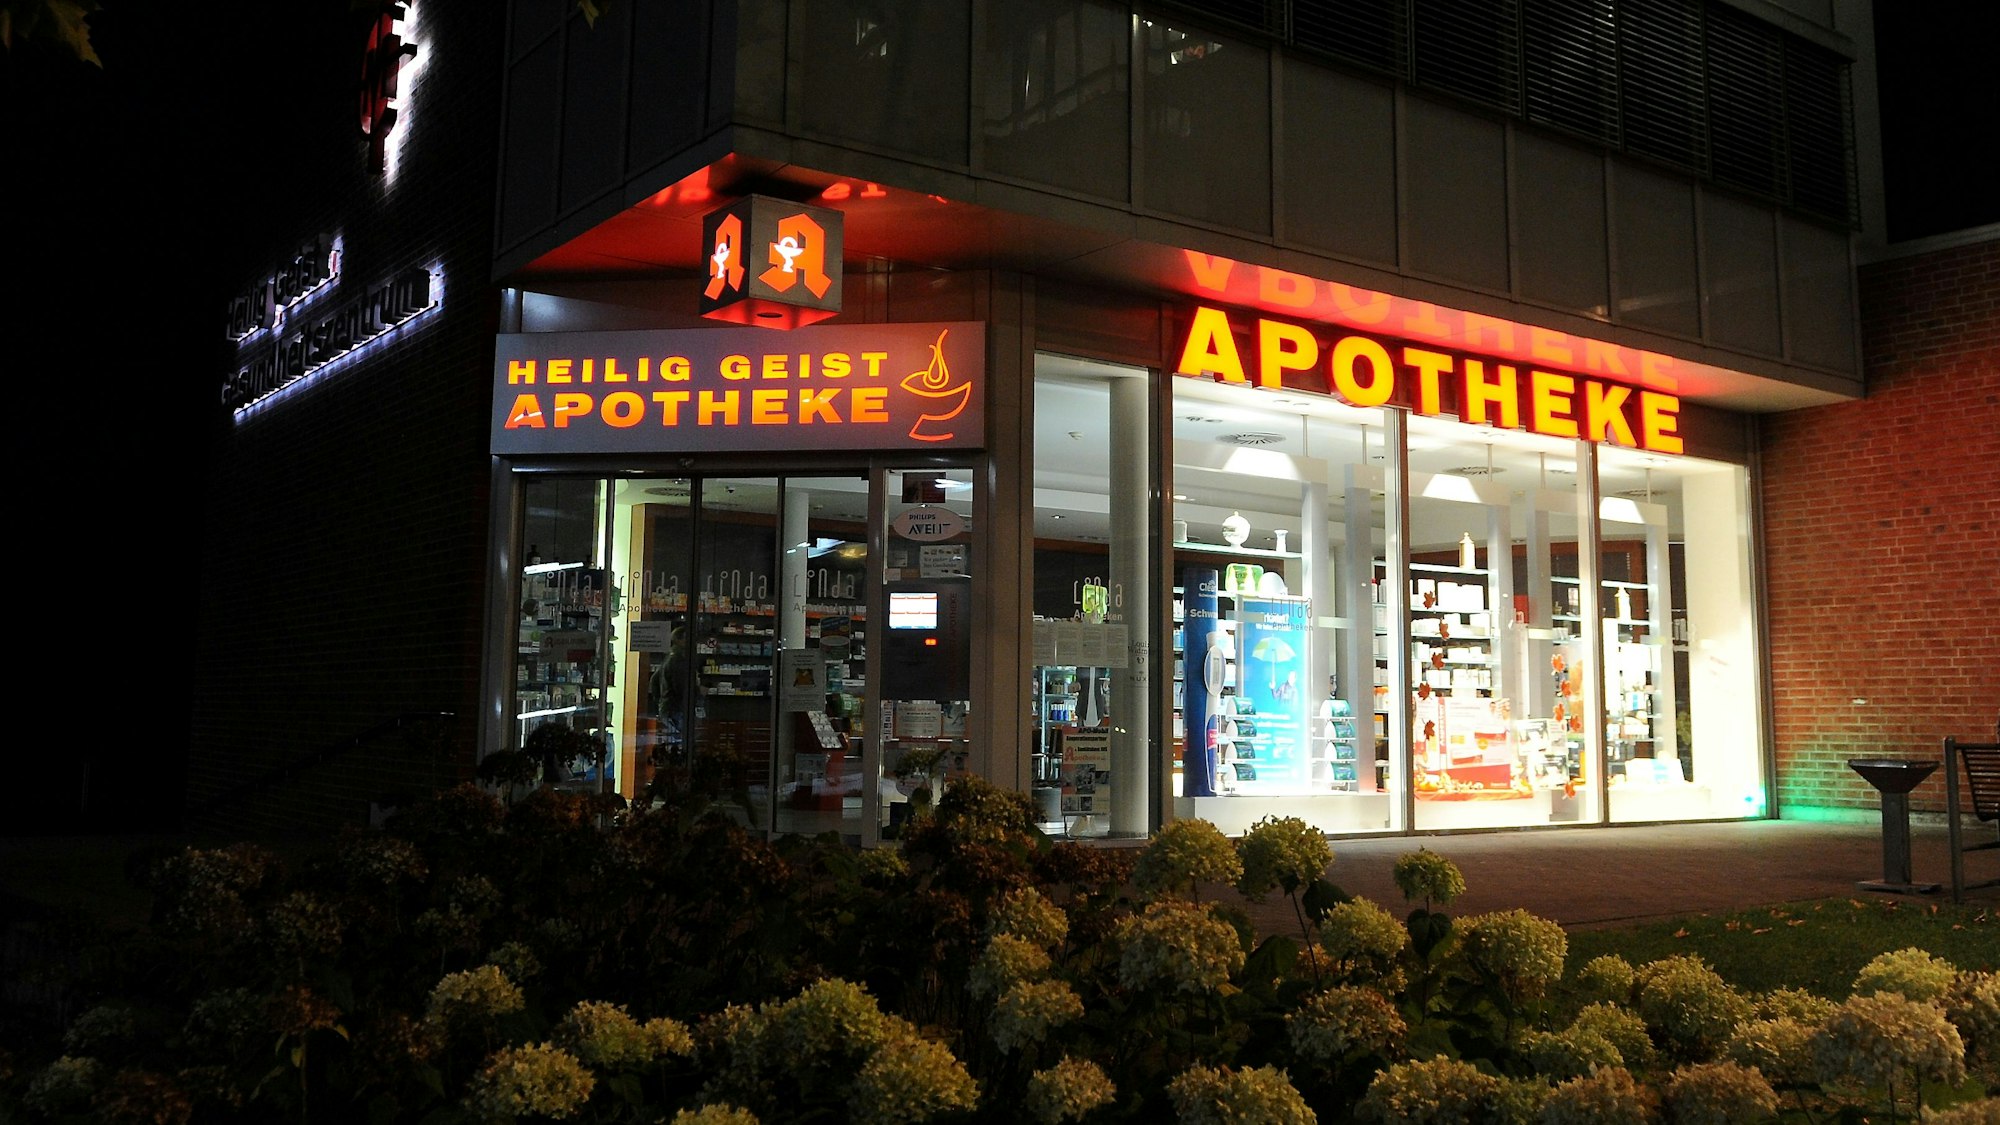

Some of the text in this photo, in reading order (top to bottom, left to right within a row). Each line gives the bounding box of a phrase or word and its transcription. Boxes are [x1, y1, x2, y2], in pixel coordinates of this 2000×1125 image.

[507, 351, 889, 385] HEILIG GEIST
[1177, 305, 1685, 456] APOTHEKE
[504, 387, 890, 430] APOTHEKE
